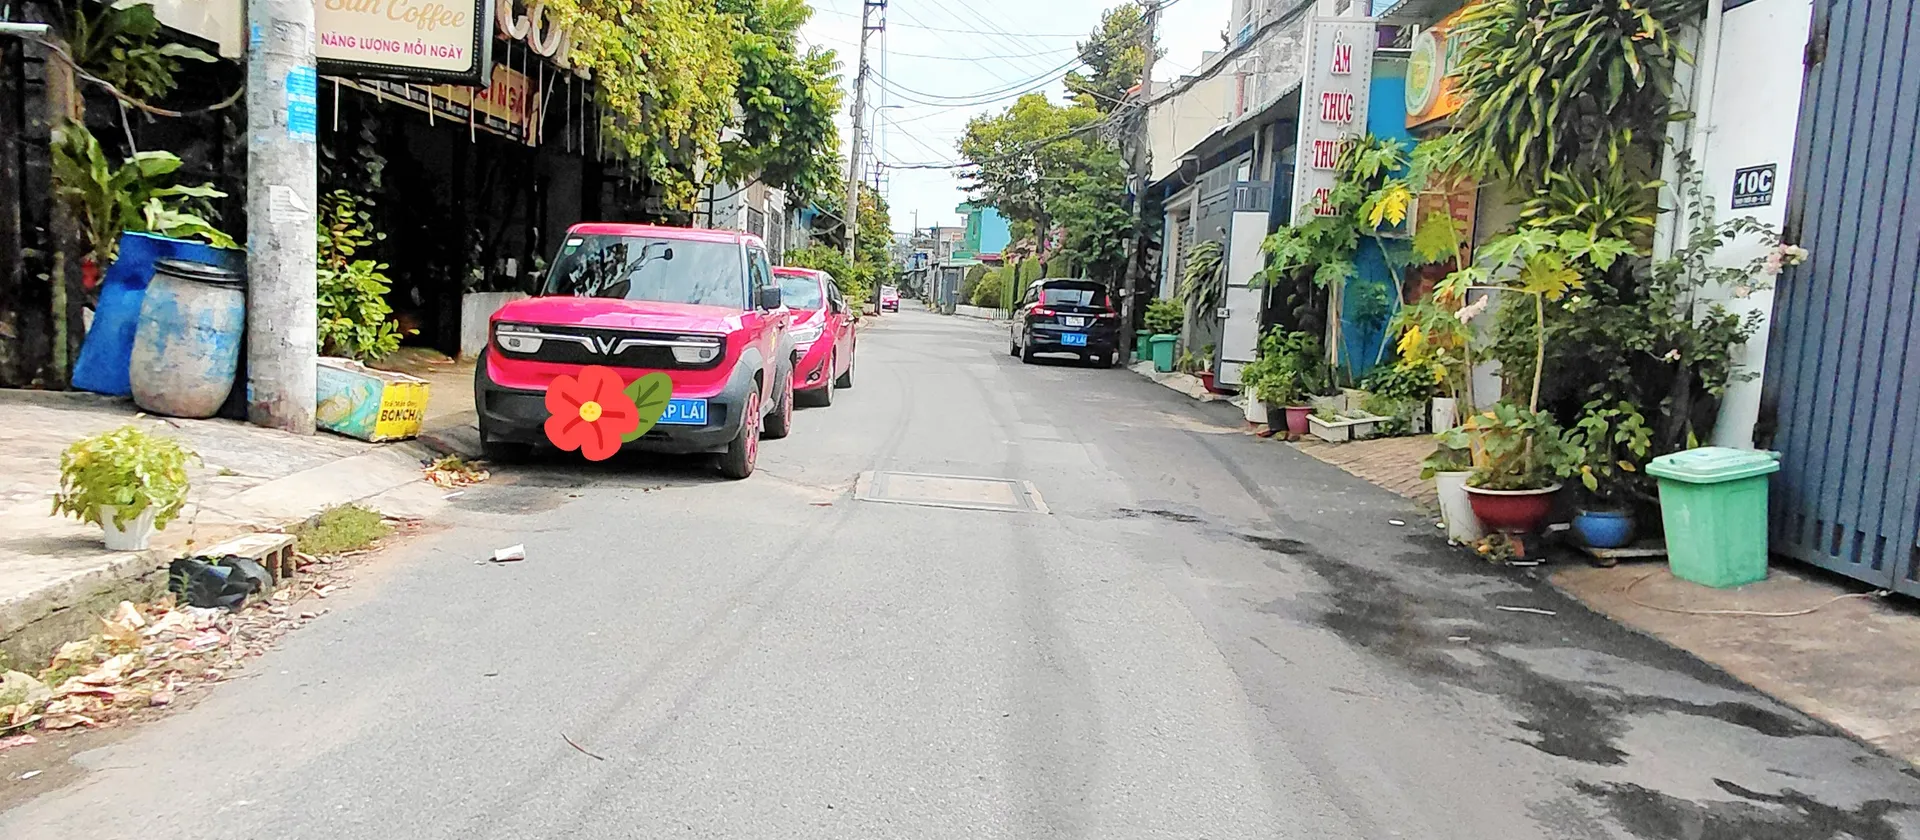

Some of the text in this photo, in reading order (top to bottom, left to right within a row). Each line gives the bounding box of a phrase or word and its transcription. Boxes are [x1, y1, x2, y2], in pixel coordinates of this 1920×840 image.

[387, 0, 466, 31] Coffee
[321, 31, 463, 59] NĂNG LƯỢNG MỖI NGÀY
[1323, 88, 1354, 126] THỰC
[1738, 170, 1772, 194] 10C
[681, 402, 704, 419] LÁI
